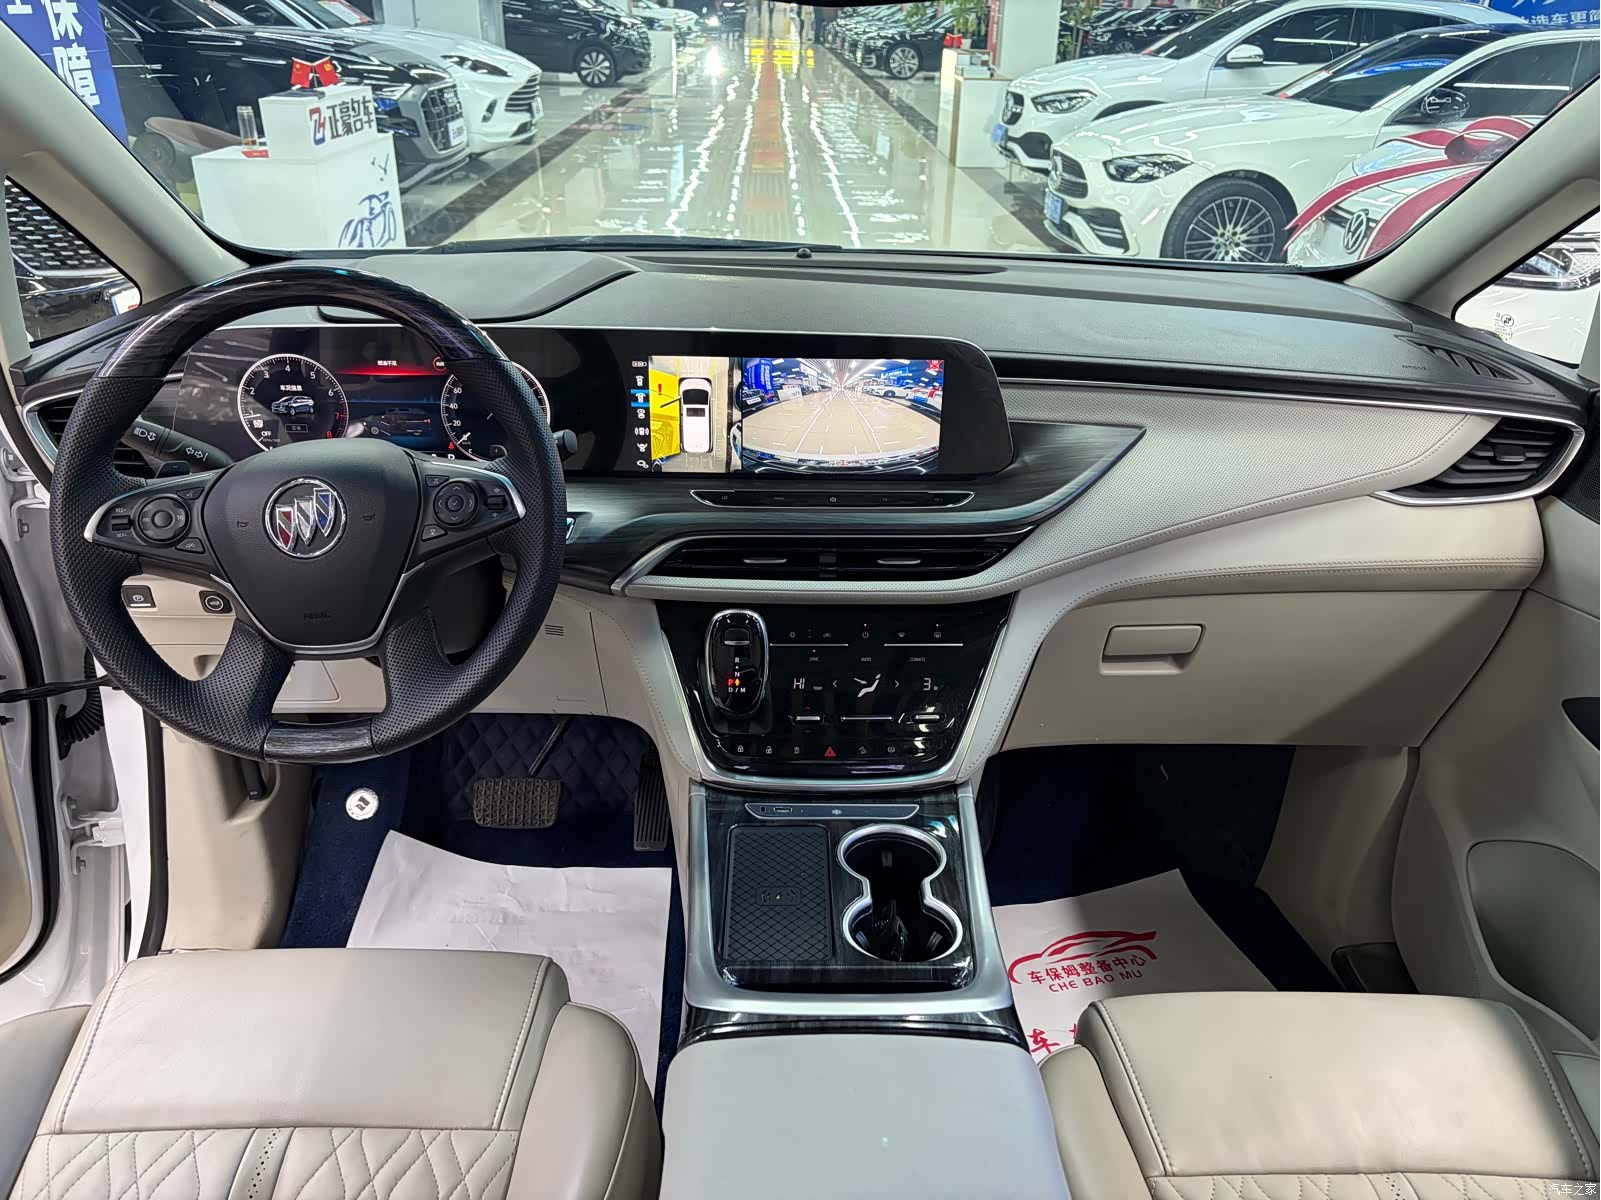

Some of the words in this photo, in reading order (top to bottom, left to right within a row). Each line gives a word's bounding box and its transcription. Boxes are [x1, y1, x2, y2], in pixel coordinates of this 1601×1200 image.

[250, 387, 255, 395] 2
[728, 678, 734, 686] P
[793, 677, 806, 690] HI
[922, 677, 931, 690] 3
[1027, 954, 1147, 985] 车保姆整备中心
[1048, 980, 1079, 993] CHE
[1082, 974, 1115, 987] BAO
[1119, 969, 1143, 981] MU
